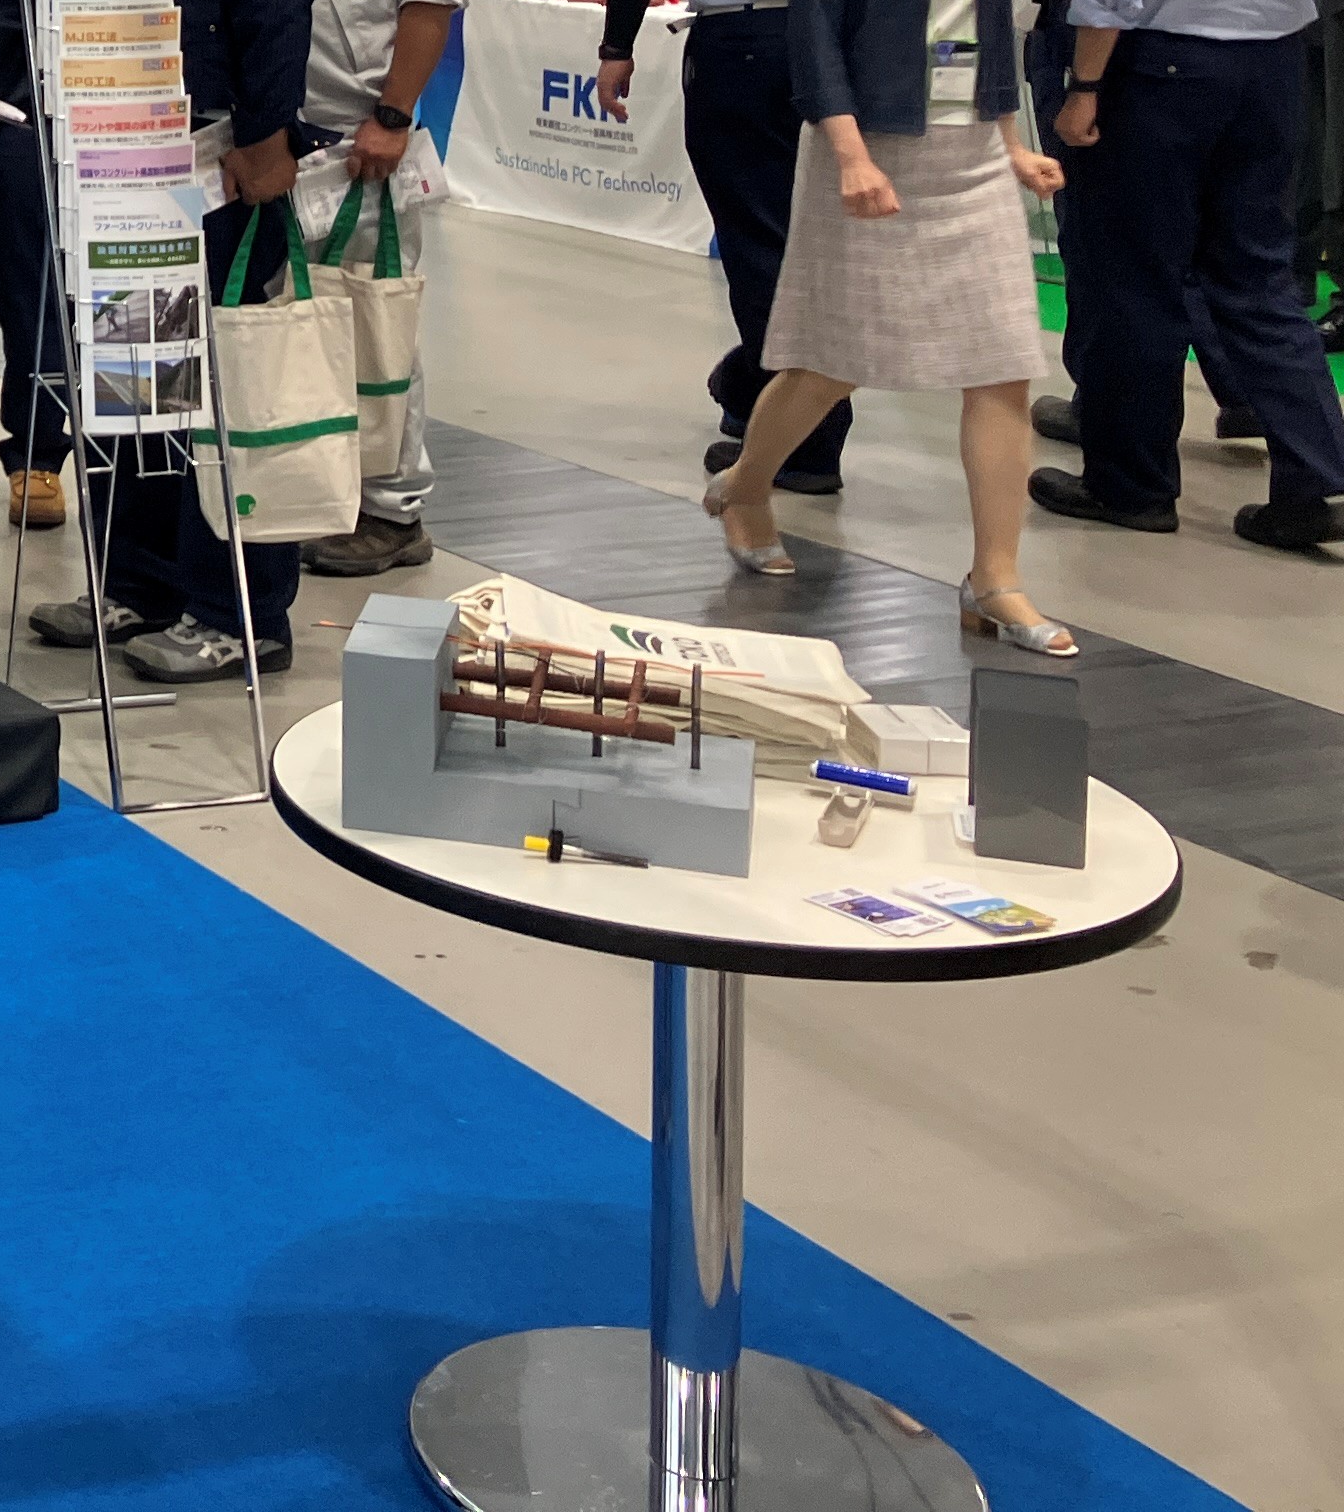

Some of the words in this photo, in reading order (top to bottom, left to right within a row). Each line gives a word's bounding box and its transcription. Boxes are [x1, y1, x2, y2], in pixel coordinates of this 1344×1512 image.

[64, 31, 117, 43] MJS工法
[63, 76, 116, 87] CPG工法
[495, 147, 568, 182] Sustainable
[572, 165, 591, 186] PC
[597, 170, 682, 202] Technology
